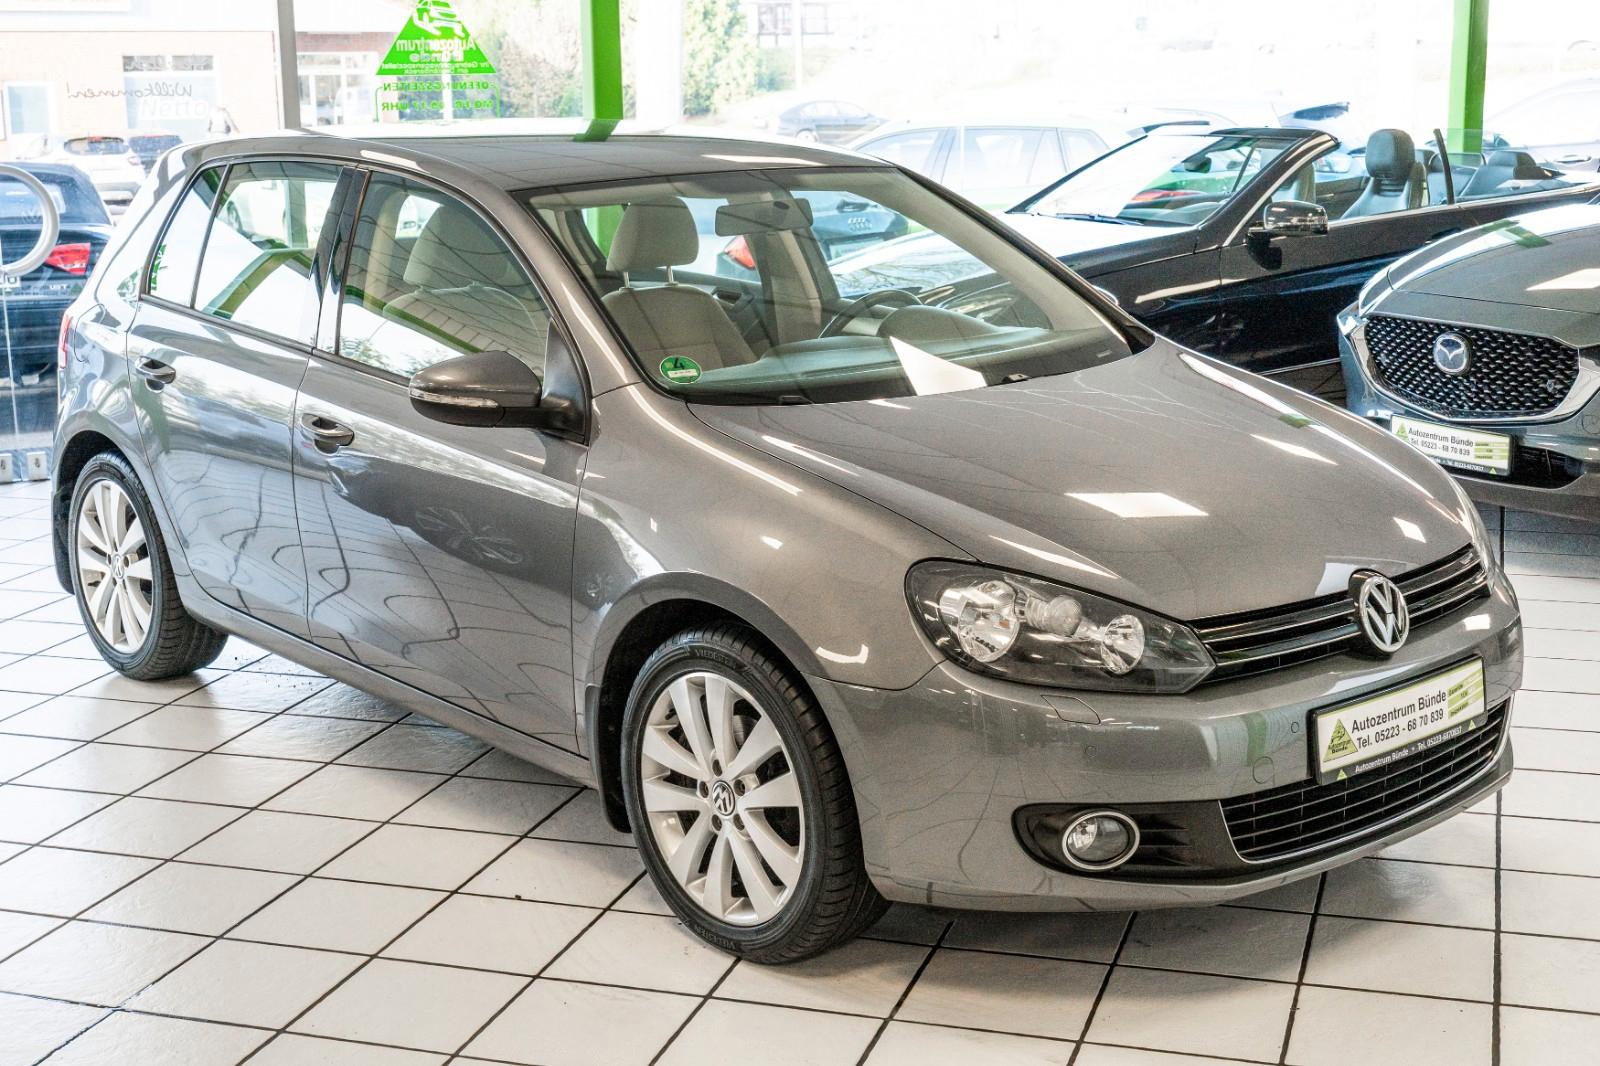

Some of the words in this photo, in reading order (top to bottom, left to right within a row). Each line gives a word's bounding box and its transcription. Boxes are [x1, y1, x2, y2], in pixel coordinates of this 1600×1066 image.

[1408, 427, 1449, 443] Autozentrum
[1351, 703, 1416, 734] Autozentrum
[1418, 690, 1447, 711] Bünde
[1356, 735, 1373, 749] Tel.
[1374, 725, 1400, 743] 05223
[1407, 718, 1417, 731] 68
[1419, 714, 1428, 727] 70
[1430, 708, 1444, 723] 839
[1355, 754, 1392, 773] Autozentrum
